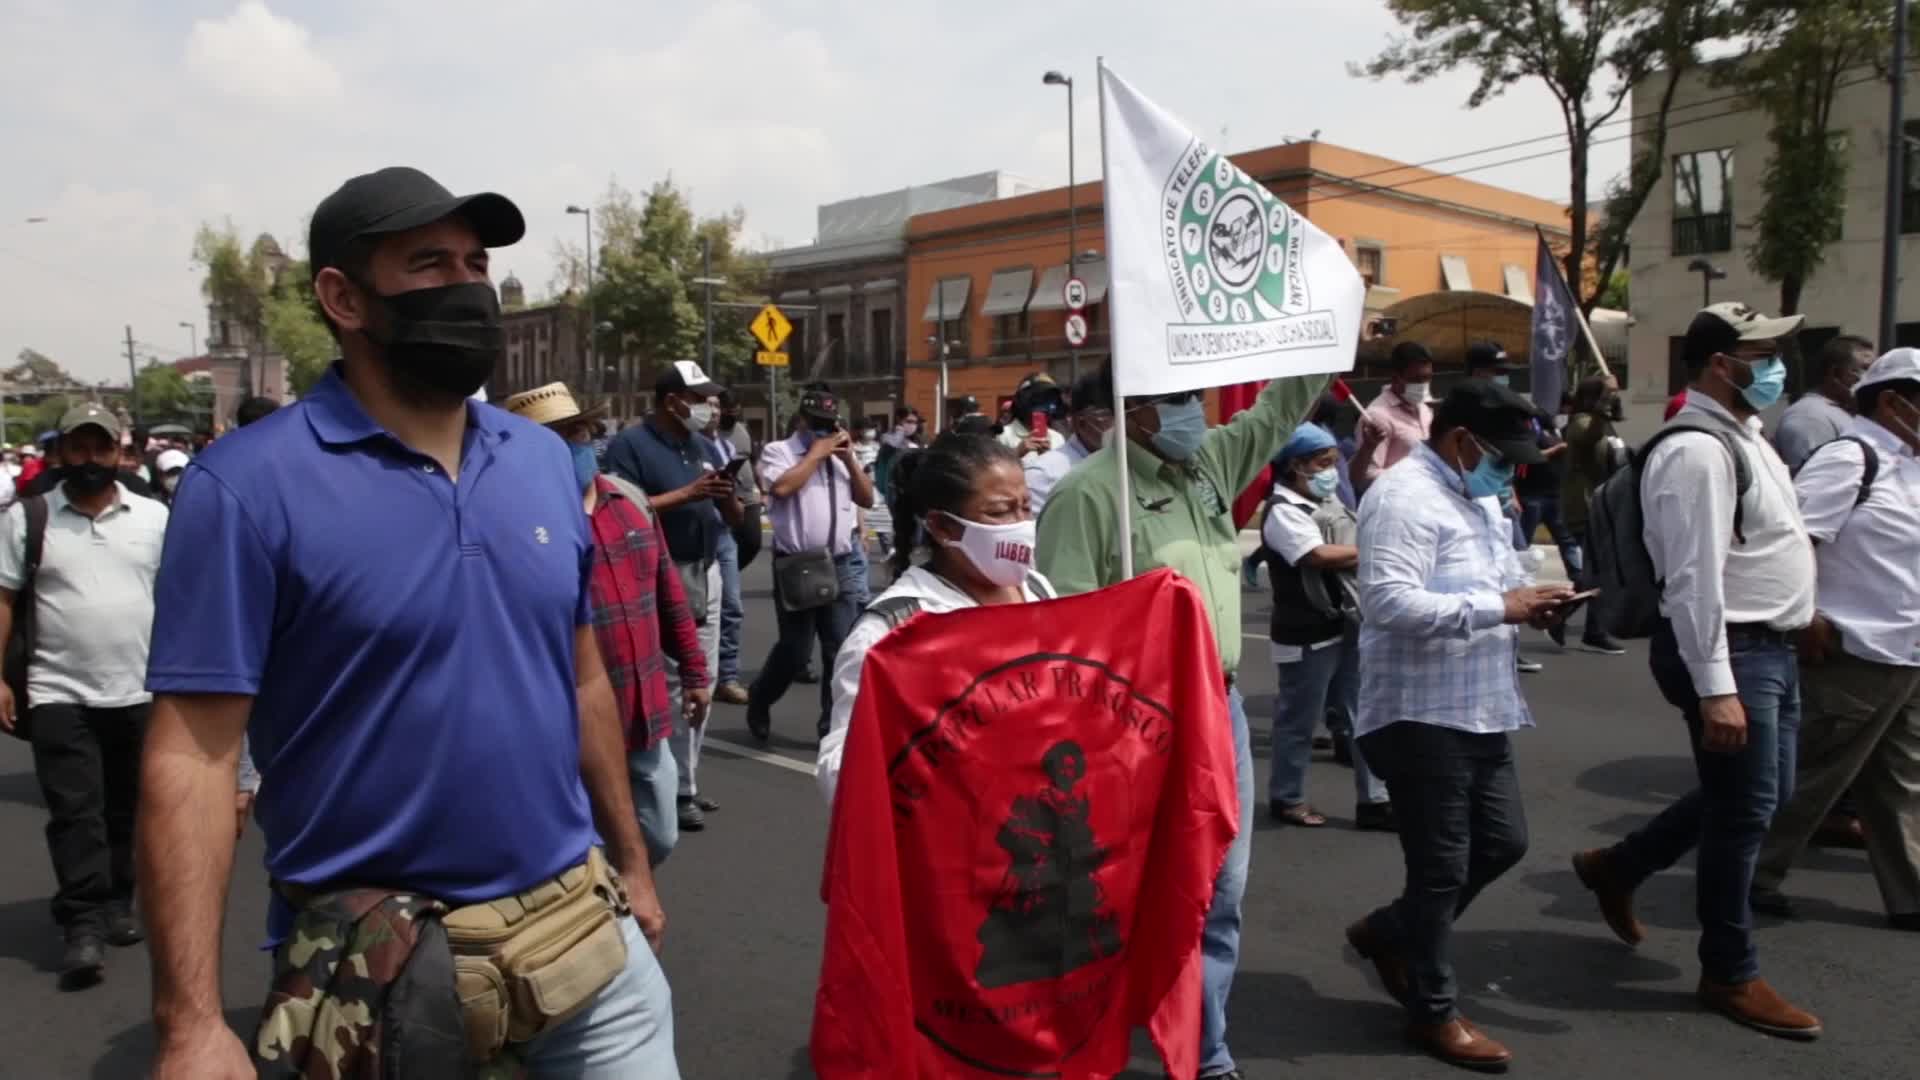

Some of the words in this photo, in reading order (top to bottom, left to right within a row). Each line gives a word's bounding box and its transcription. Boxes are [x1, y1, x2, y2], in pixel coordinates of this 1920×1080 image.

[1220, 162, 1229, 182] 5
[1200, 188, 1209, 210] 6
[1165, 198, 1178, 221] DE
[1273, 210, 1281, 228] 2
[1187, 227, 1196, 248] 7
[1165, 226, 1194, 316] SINDICATO
[1196, 269, 1205, 289] 8
[1213, 296, 1222, 315] 9
[1238, 303, 1246, 321] 0
